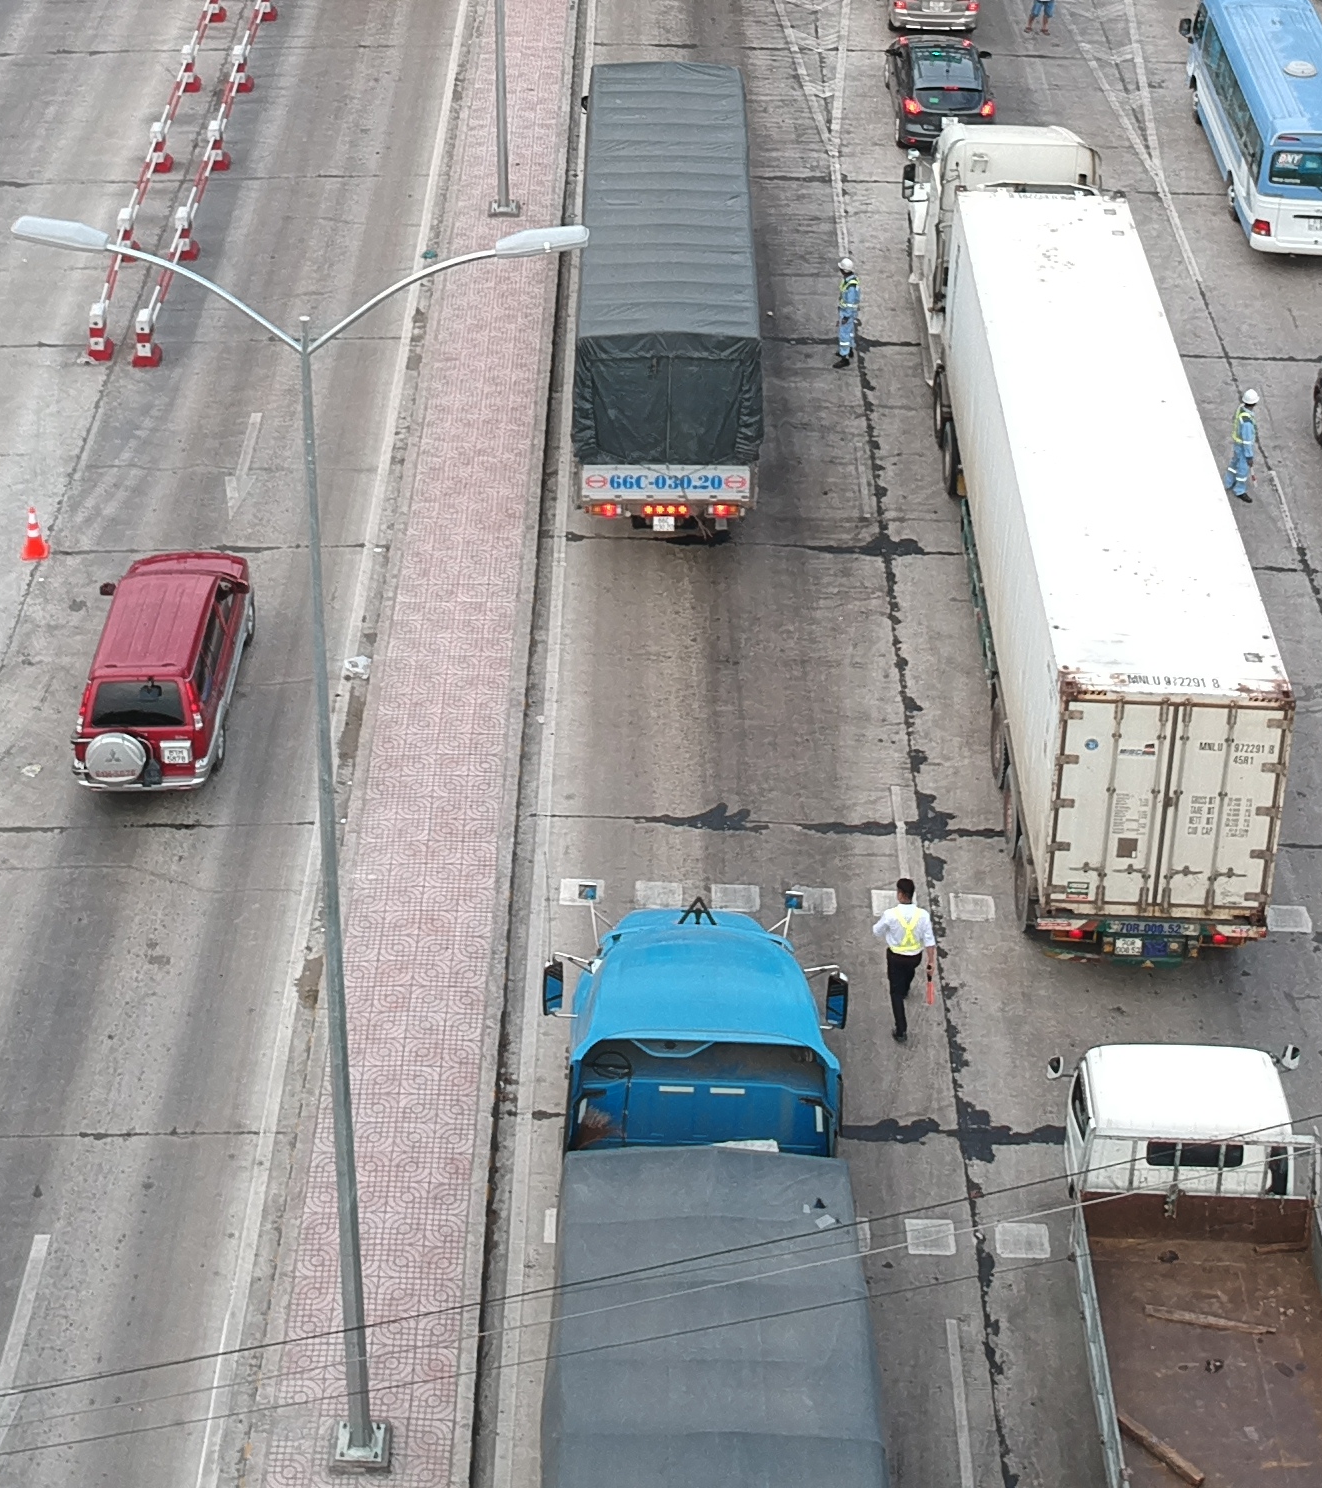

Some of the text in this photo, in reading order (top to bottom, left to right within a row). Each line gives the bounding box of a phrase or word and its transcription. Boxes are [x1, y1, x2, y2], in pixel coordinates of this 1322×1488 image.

[609, 474, 723, 490] 66C-030.20
[1212, 678, 1220, 689] 8
[1199, 741, 1223, 752] MNLU
[1233, 743, 1265, 754] 972291
